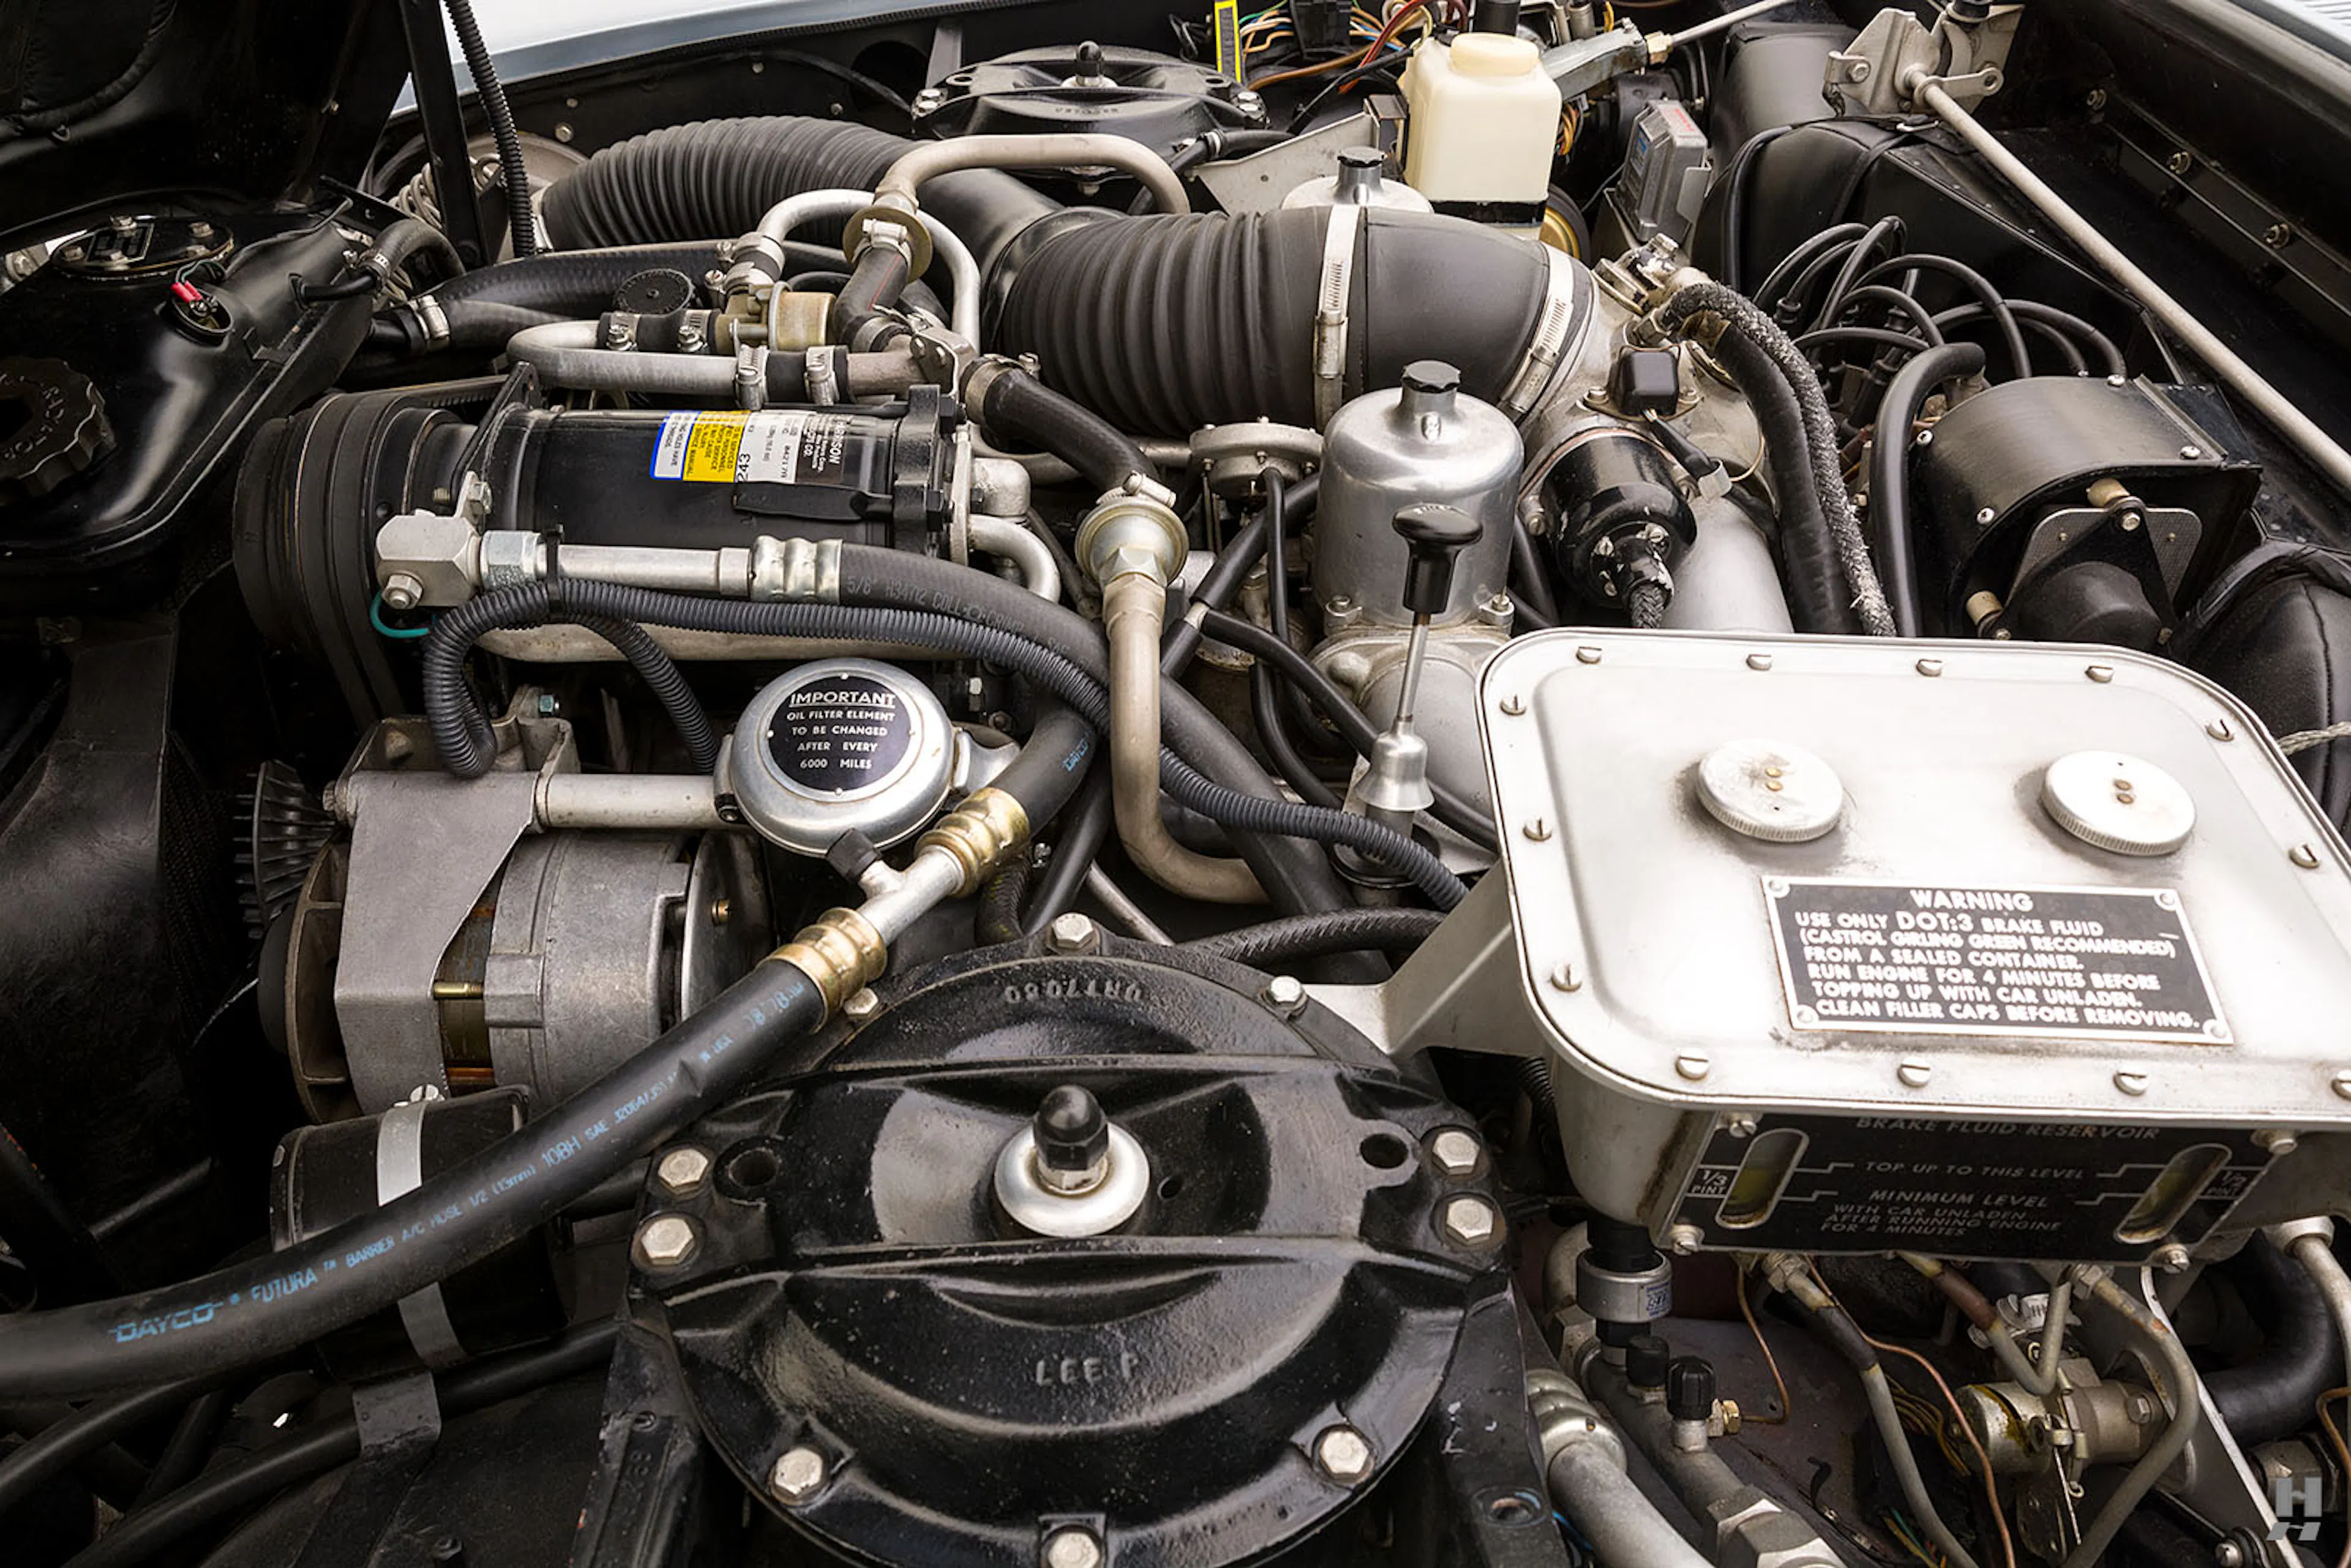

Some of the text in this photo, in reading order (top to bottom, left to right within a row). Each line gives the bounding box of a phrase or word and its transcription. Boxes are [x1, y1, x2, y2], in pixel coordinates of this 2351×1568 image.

[790, 691, 897, 705] IMPORTANT
[787, 710, 896, 721] OIL FILTER ELEMENT
[792, 725, 888, 737] TO BE CHANGED
[797, 741, 879, 752] AFTER EVERY
[800, 759, 872, 770] 6000 MILES
[1909, 889, 2034, 912] WARNING
[1794, 910, 2104, 937] USE ONLY DOT:3 BRAKE FLUID
[1799, 928, 2176, 959] (CASTROL GIRLING GREEN RECOMMENDED)
[1803, 946, 2085, 971] FROM A SEALED CONTAINER.
[1807, 962, 2162, 991] RUN ENGINE FOR 4 MINUTES BEFORE
[1810, 980, 2143, 1009] TOPPING UP WITH CAR UNLADEN.
[1815, 999, 2200, 1029] CLEAN FILLER CAPS BEFORE REMOVING.
[1856, 1117, 2161, 1140] BRAKE FLUID RESERVOIR
[1702, 1169, 1728, 1187] 1/3
[1865, 1161, 2085, 1180] TOP UP TO THIS LEVEL
[1692, 1185, 1728, 1195] PINT
[1868, 1189, 2049, 1209] MINIMUM LEVEL
[1833, 1202, 2028, 1221] WITH CAR UNLADEN
[116, 1302, 216, 1343] DAYCO
[250, 1267, 319, 1303] FUTURA
[345, 1235, 396, 1269] BARRIER
[402, 1222, 426, 1243] A/C
[430, 1202, 463, 1228] HOSE
[469, 1189, 489, 1209] 1/2
[584, 1119, 610, 1141] SAE
[1820, 1222, 1968, 1238] FOR 4 MINUTES
[1824, 1212, 2062, 1232] AFTER RUNNING ENGINE
[1036, 1357, 1103, 1387] LEE
